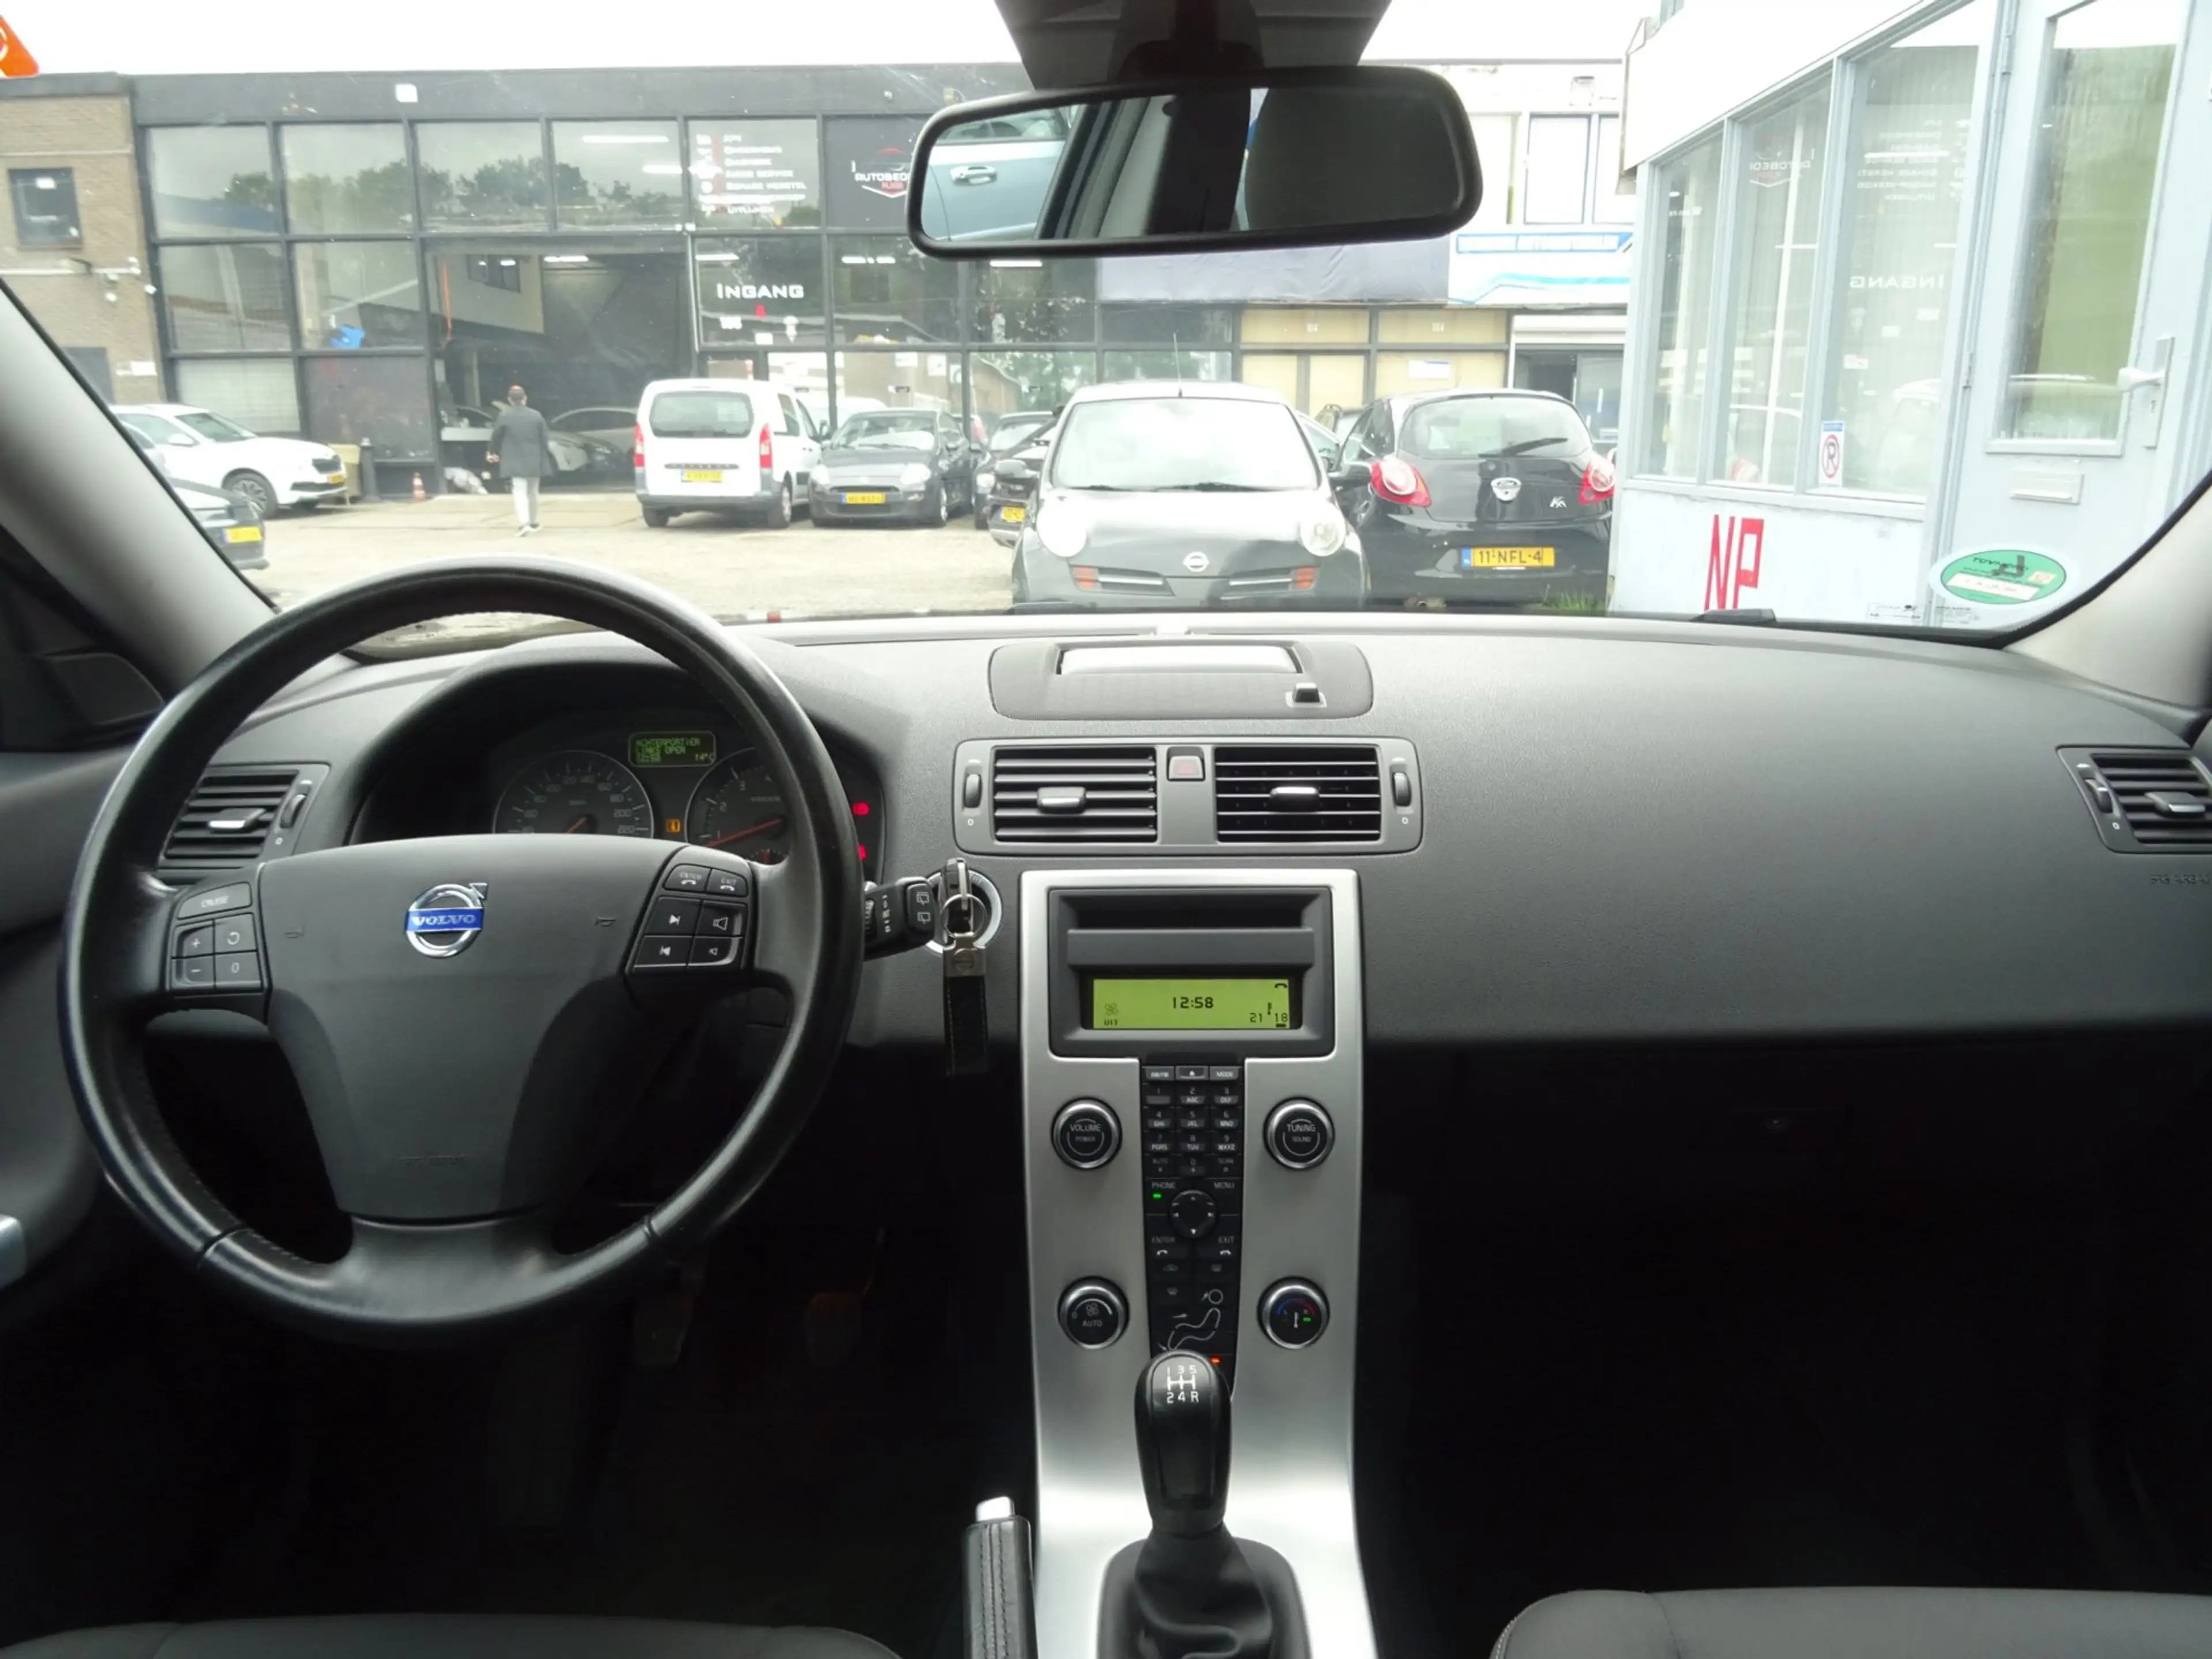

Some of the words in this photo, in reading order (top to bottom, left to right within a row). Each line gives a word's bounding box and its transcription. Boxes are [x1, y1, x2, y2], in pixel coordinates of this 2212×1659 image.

[717, 283, 804, 299] INGANG
[1479, 550, 1543, 563] 11-NFL-4
[411, 914, 476, 926] VOLVO
[1172, 996, 1214, 1009] 12:58
[1070, 1124, 1101, 1132] VOLUME
[1287, 1124, 1316, 1132] TUNING
[1189, 1365, 1197, 1374] 5
[1166, 1391, 1174, 1403] 2
[1177, 1391, 1185, 1402] 4
[1190, 1391, 1199, 1403] R
